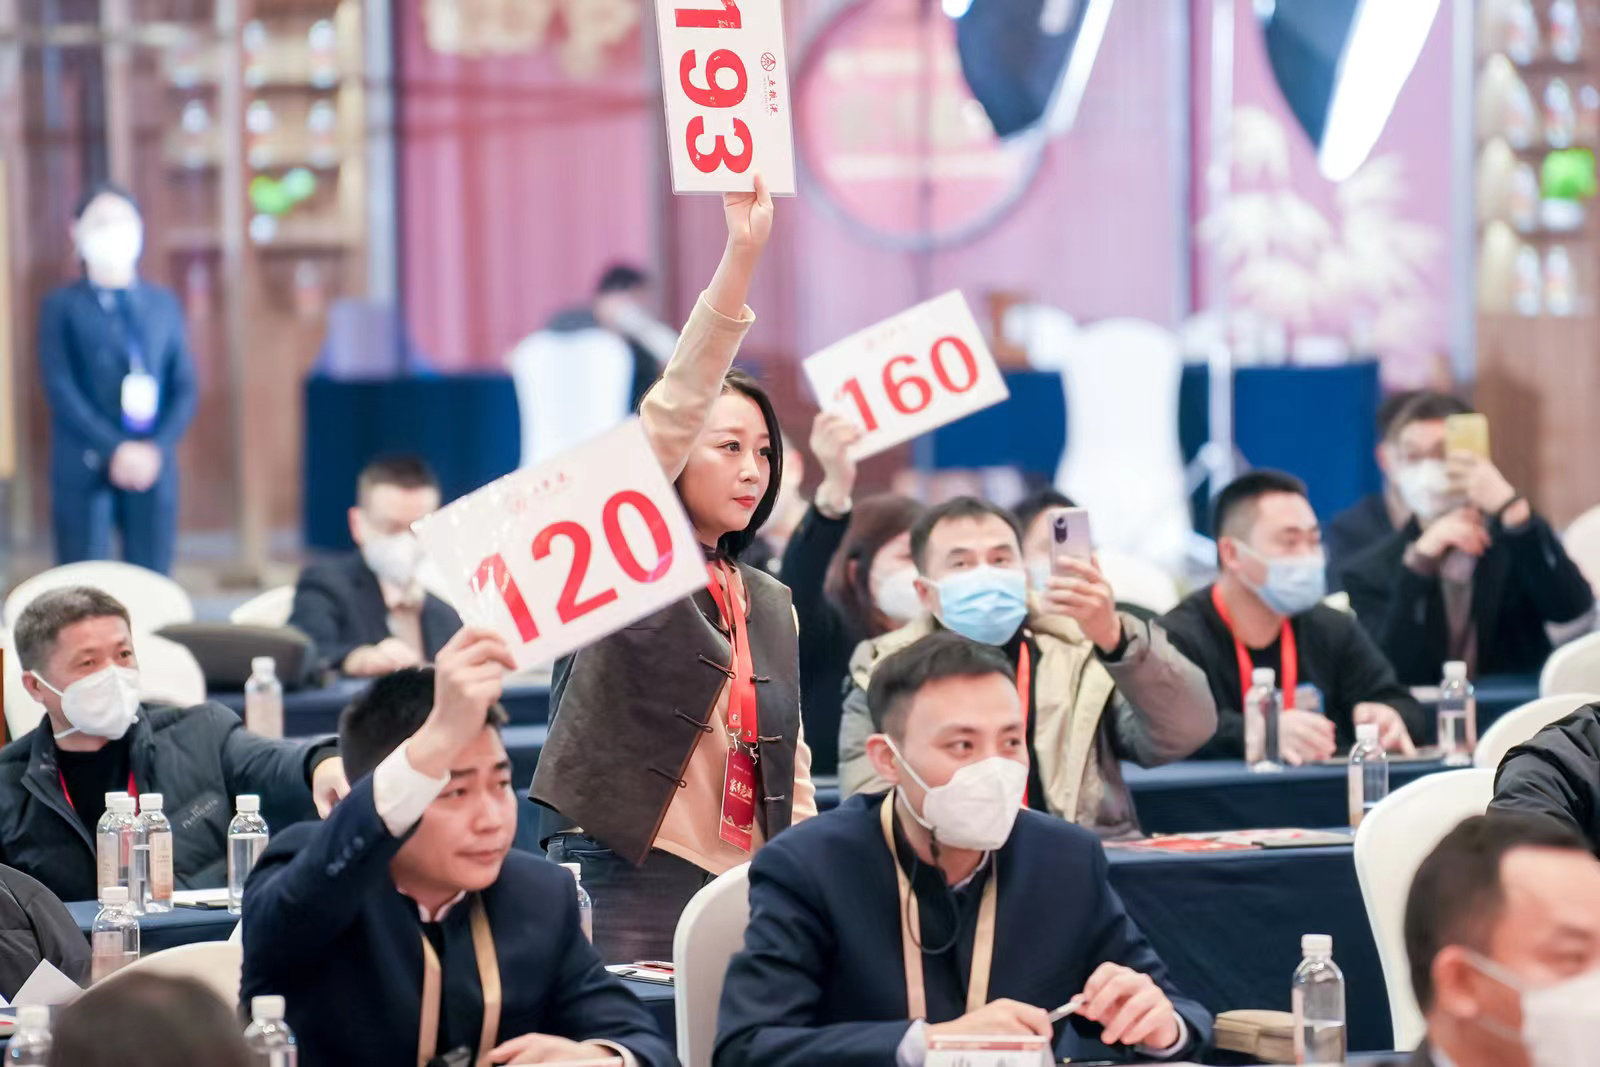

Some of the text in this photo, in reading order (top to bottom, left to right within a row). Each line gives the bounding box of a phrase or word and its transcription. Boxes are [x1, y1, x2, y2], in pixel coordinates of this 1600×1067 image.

[674, 0, 753, 174] 193
[834, 336, 979, 432] 160
[468, 489, 675, 644] 120
